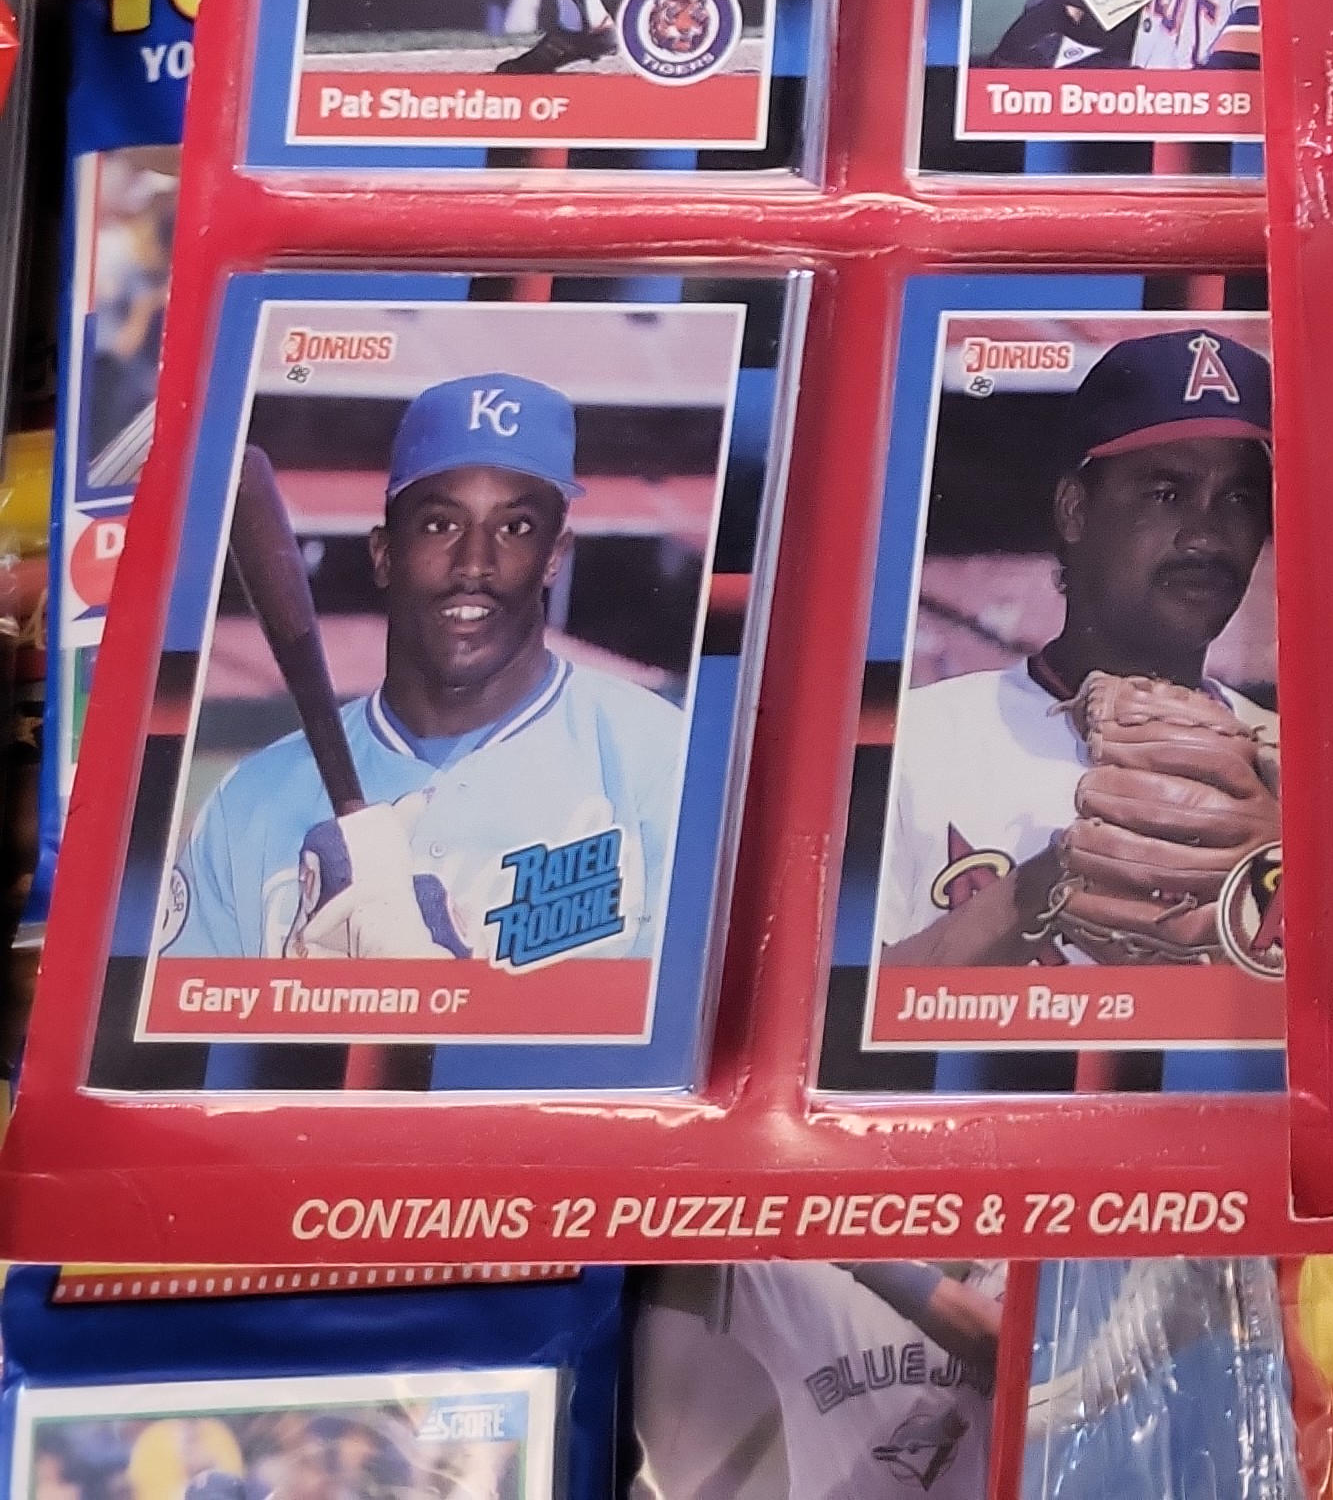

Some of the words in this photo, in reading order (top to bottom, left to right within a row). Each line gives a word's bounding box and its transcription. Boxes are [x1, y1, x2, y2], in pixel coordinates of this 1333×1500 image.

[640, 51, 717, 77] TIGERS
[320, 88, 372, 120] Pat
[379, 87, 522, 121] Sheridan
[529, 97, 570, 121] OF
[986, 83, 1051, 115] Tom
[1060, 84, 1211, 116] Brookens
[1216, 94, 1251, 115] 3B
[284, 331, 394, 363] DONRUSS
[965, 340, 1071, 373] DONRUSS
[468, 388, 521, 437] KC
[502, 828, 622, 906] RATED
[484, 880, 625, 967] ROOKIE
[178, 979, 259, 1019] Gary
[269, 979, 419, 1014] Thurman
[430, 988, 470, 1013] OF
[897, 987, 1018, 1026] Johnny
[1028, 986, 1090, 1026] Ray
[1097, 994, 1134, 1019] 2B
[292, 1197, 533, 1241] CONTAINS
[550, 1197, 594, 1239] 12
[606, 1196, 783, 1239] PUZZLE
[795, 1195, 963, 1238] PIECES
[975, 1195, 1006, 1235] &
[1022, 1193, 1076, 1235] 72
[1088, 1191, 1249, 1234] CARDS
[802, 1341, 926, 1415] BLUE
[418, 1402, 506, 1440] SCORE
